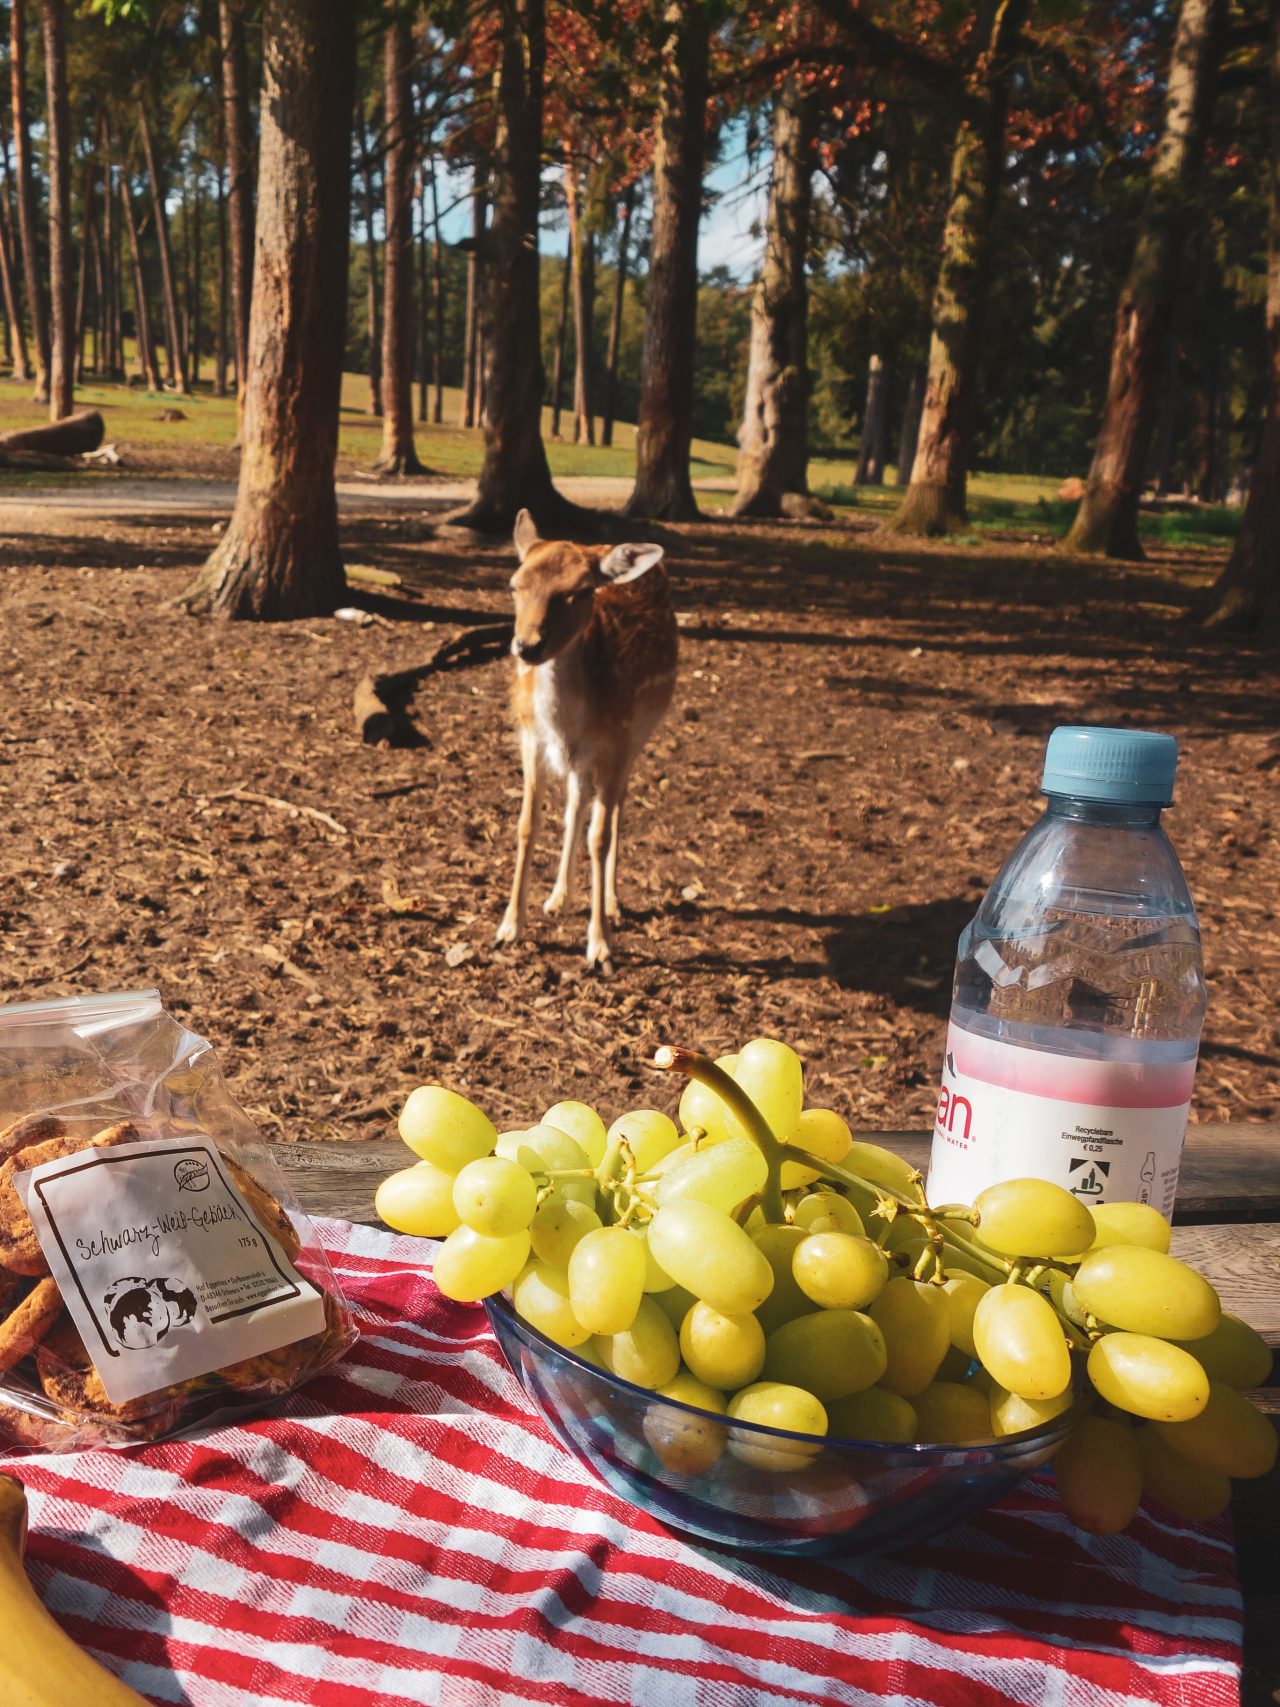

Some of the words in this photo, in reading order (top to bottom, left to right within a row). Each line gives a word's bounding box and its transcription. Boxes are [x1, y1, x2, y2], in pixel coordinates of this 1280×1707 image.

[946, 1137, 969, 1151] WATER
[1088, 1144, 1103, 1153] 0,25
[76, 1204, 242, 1260] Schwarz-Weiß-Gebäck
[238, 1237, 251, 1248] 175
[252, 1239, 258, 1248] g
